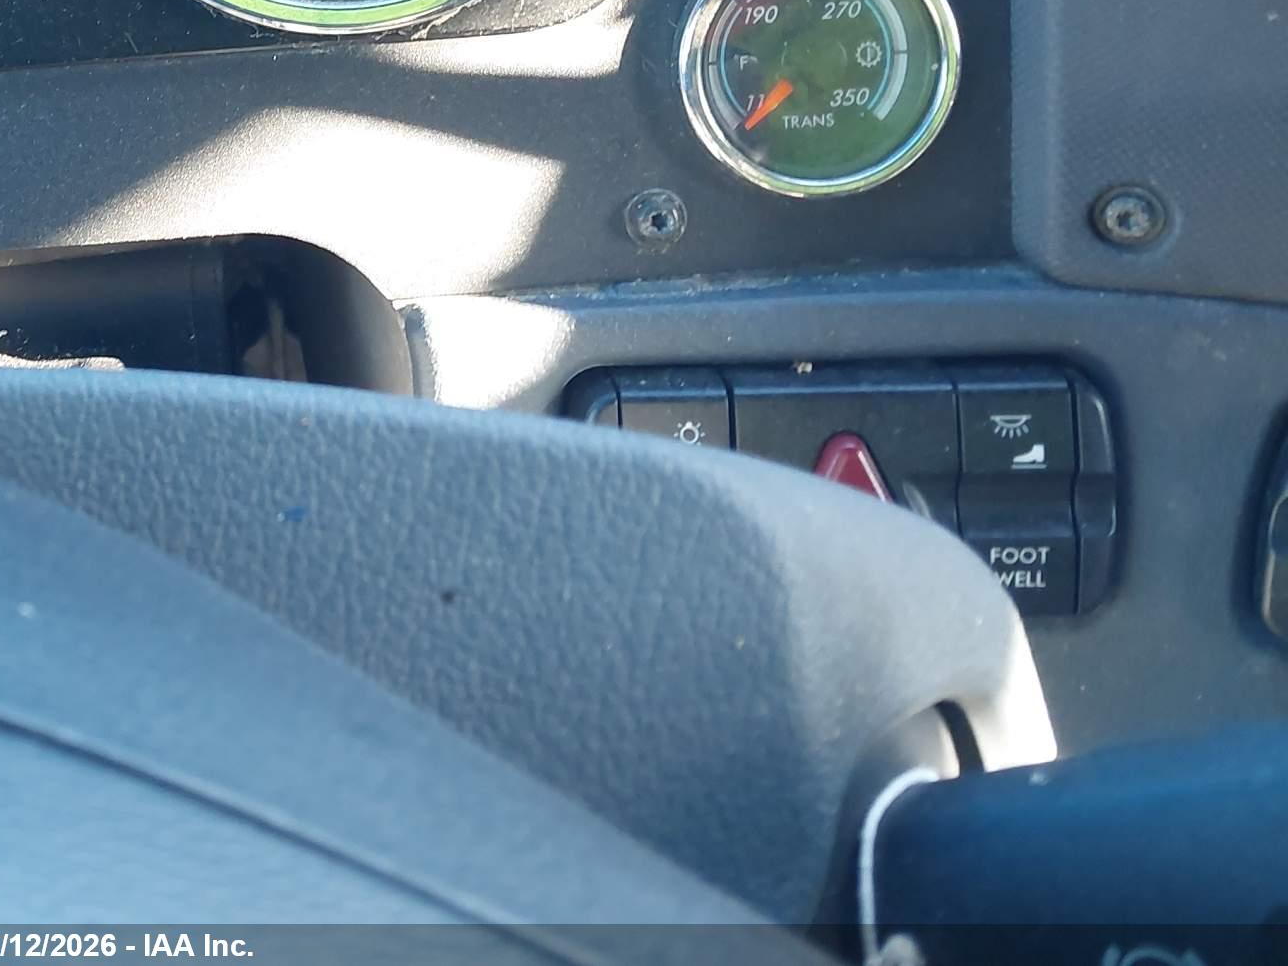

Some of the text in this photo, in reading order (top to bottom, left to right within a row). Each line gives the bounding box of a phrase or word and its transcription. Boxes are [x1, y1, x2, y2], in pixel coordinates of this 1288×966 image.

[744, 5, 778, 24] 190
[822, 0, 861, 20] 270
[830, 88, 869, 107] 350
[782, 113, 834, 129] TRANS
[990, 547, 1050, 564] FOOT
[995, 570, 1046, 588] WELL
